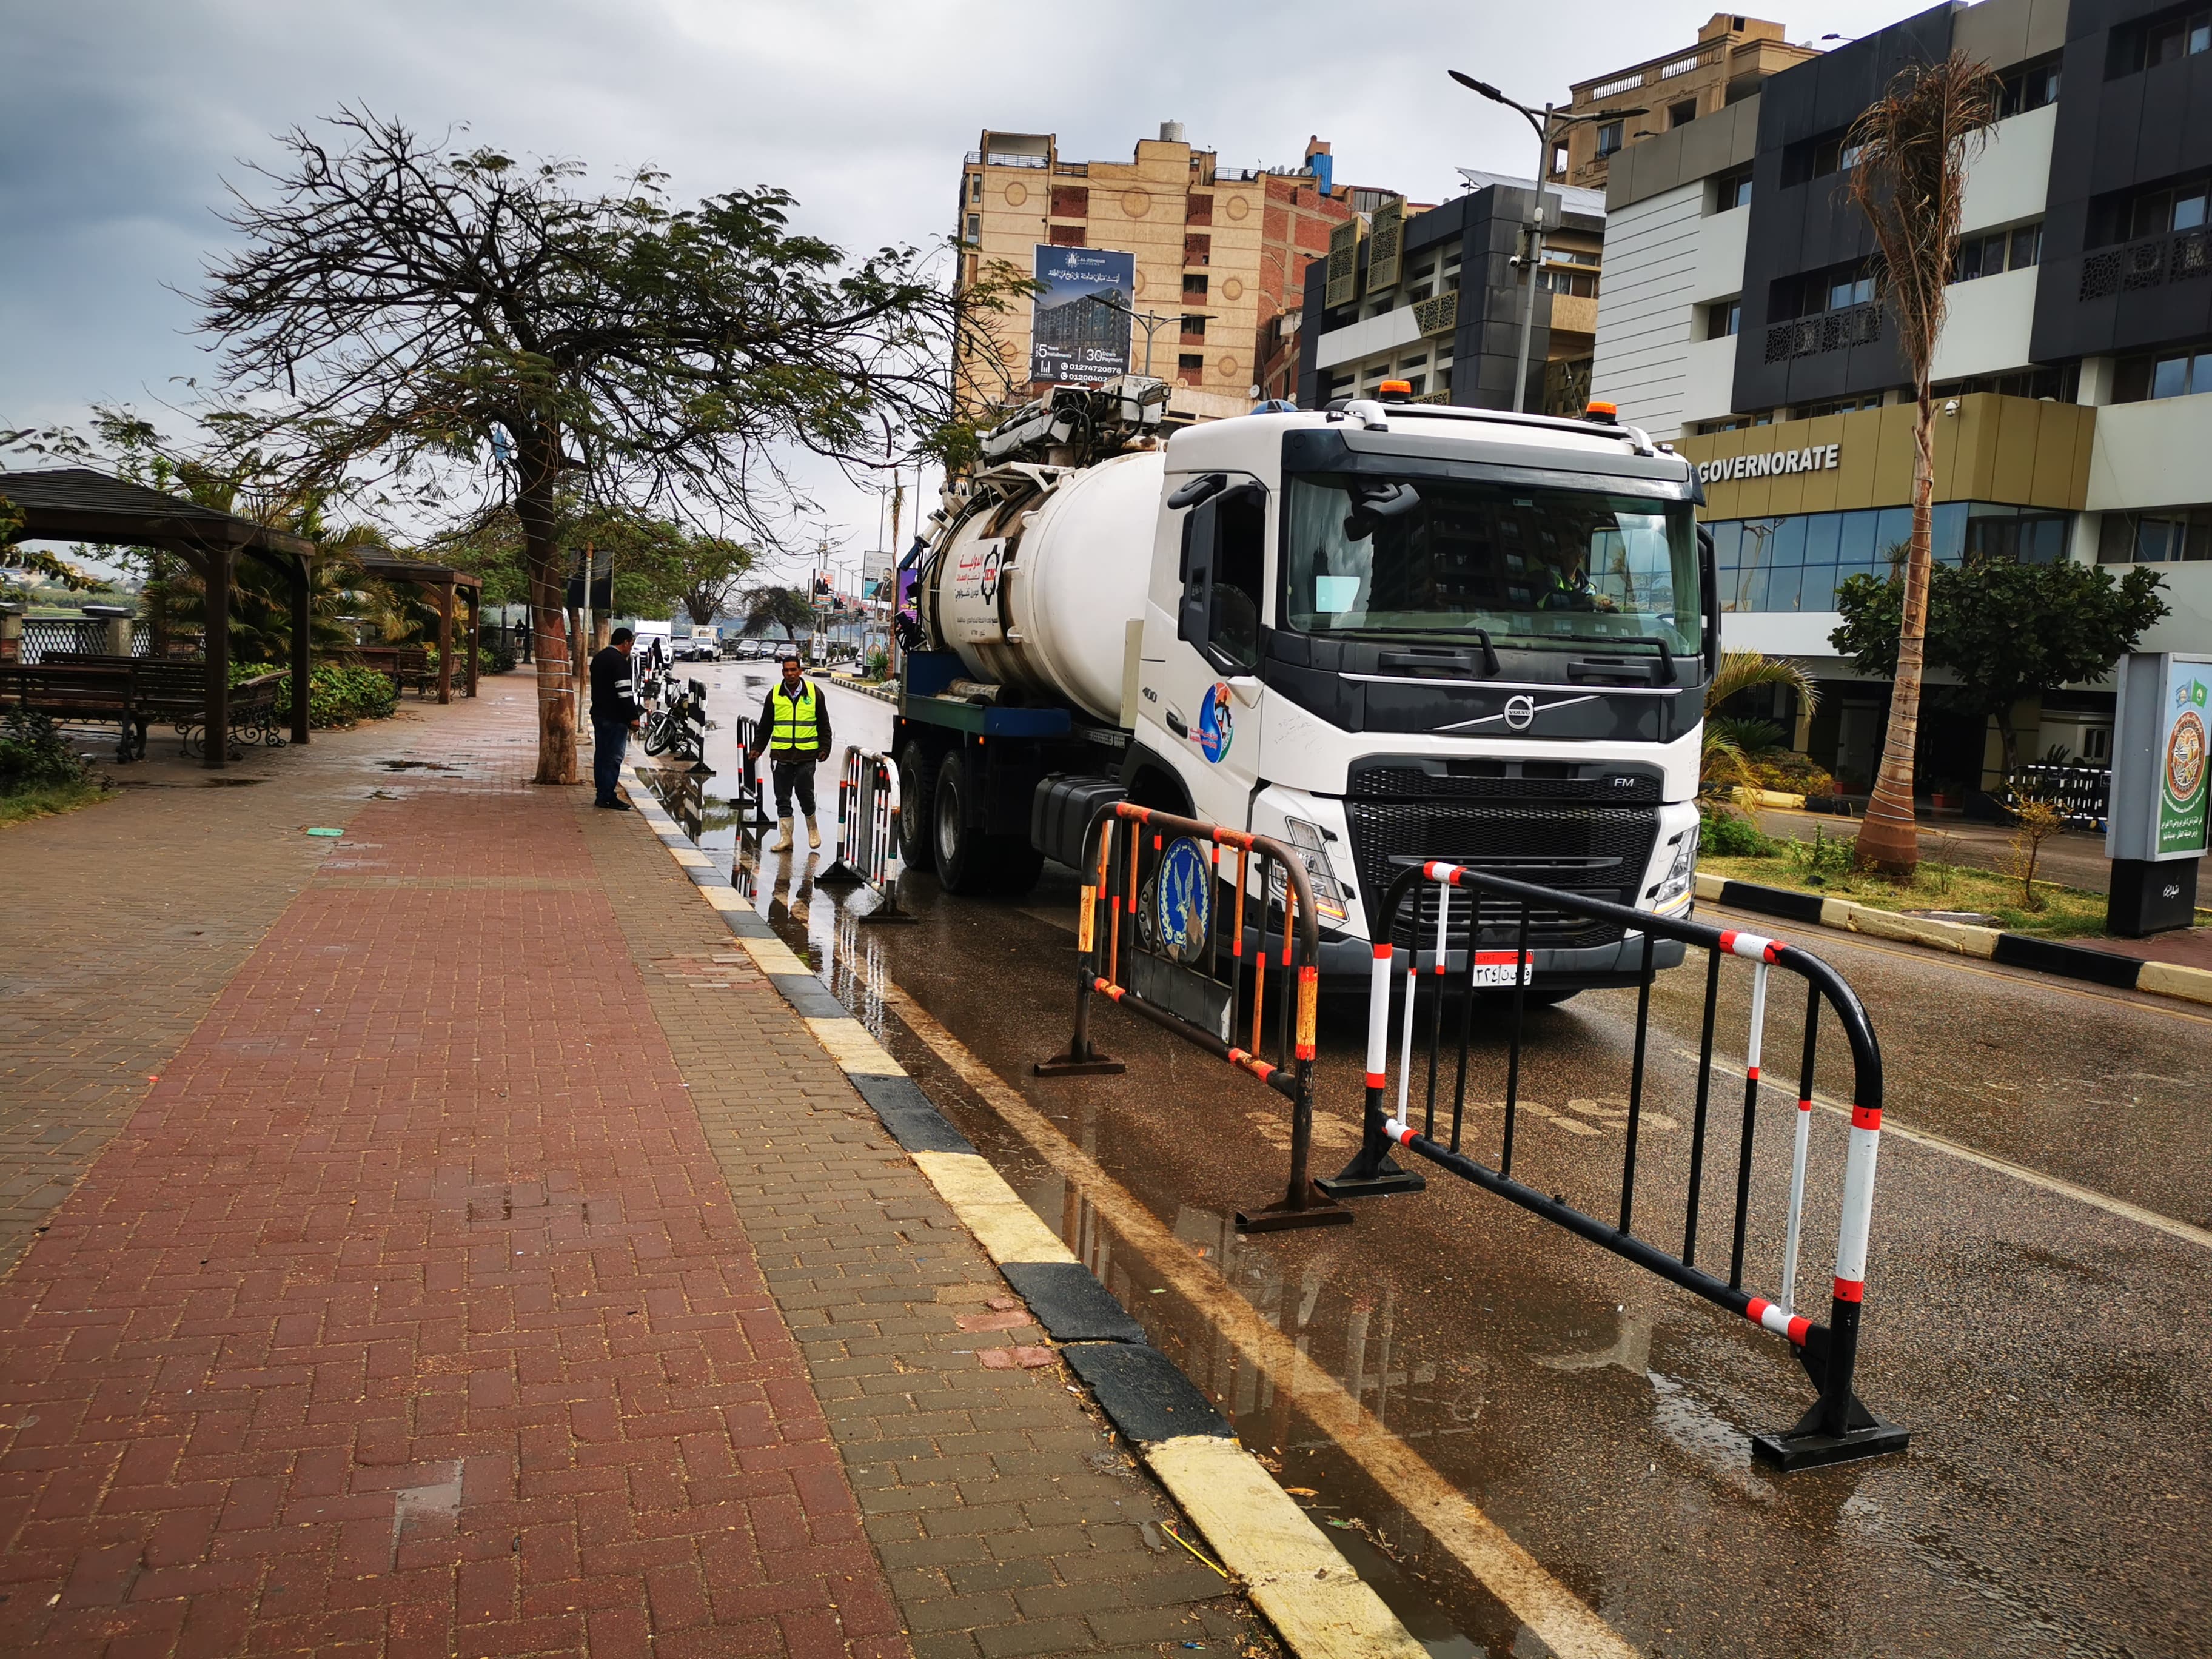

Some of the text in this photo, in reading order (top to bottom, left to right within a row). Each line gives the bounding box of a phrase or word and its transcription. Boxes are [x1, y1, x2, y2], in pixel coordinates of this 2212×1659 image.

[1039, 344, 1047, 358] 5
[1697, 444, 1838, 484] GOVERNORATE
[1142, 687, 1158, 703] 400
[1614, 778, 1635, 787] FM
